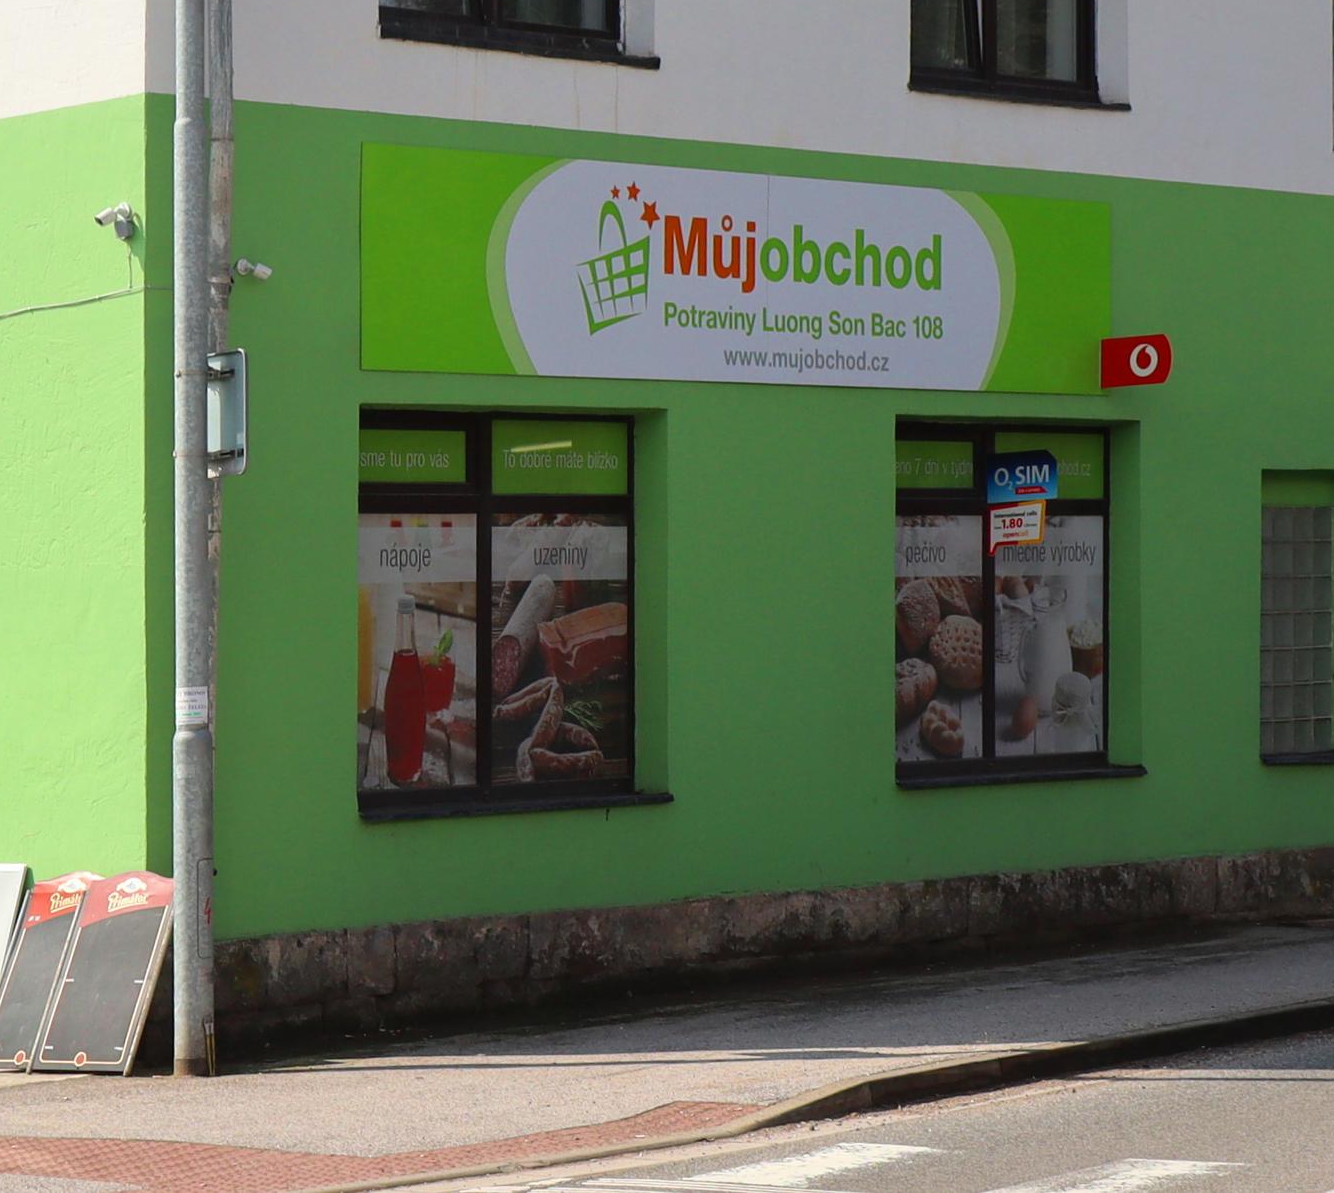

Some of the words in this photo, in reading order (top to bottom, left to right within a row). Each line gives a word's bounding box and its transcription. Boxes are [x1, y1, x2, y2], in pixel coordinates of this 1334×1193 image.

[664, 213, 943, 293] Můjobchod
[664, 302, 756, 336] Potraviny
[763, 307, 822, 340] Luong
[828, 310, 866, 337] Son
[871, 314, 906, 338] Bac
[913, 315, 944, 340] 108
[723, 347, 890, 373] www.mujobchod.cz
[359, 451, 385, 467] sme
[390, 450, 402, 467] tu
[405, 452, 426, 470] pro
[429, 448, 450, 468] vás
[503, 450, 516, 468] To
[519, 449, 552, 469] dobré
[555, 450, 583, 469] máte
[1015, 464, 1050, 485] SIM
[1001, 517, 1023, 529] 1.80
[379, 542, 431, 572] nápoje
[533, 544, 588, 569] uzeniny
[906, 541, 946, 566] pečivo
[1050, 540, 1096, 565] výrobky
